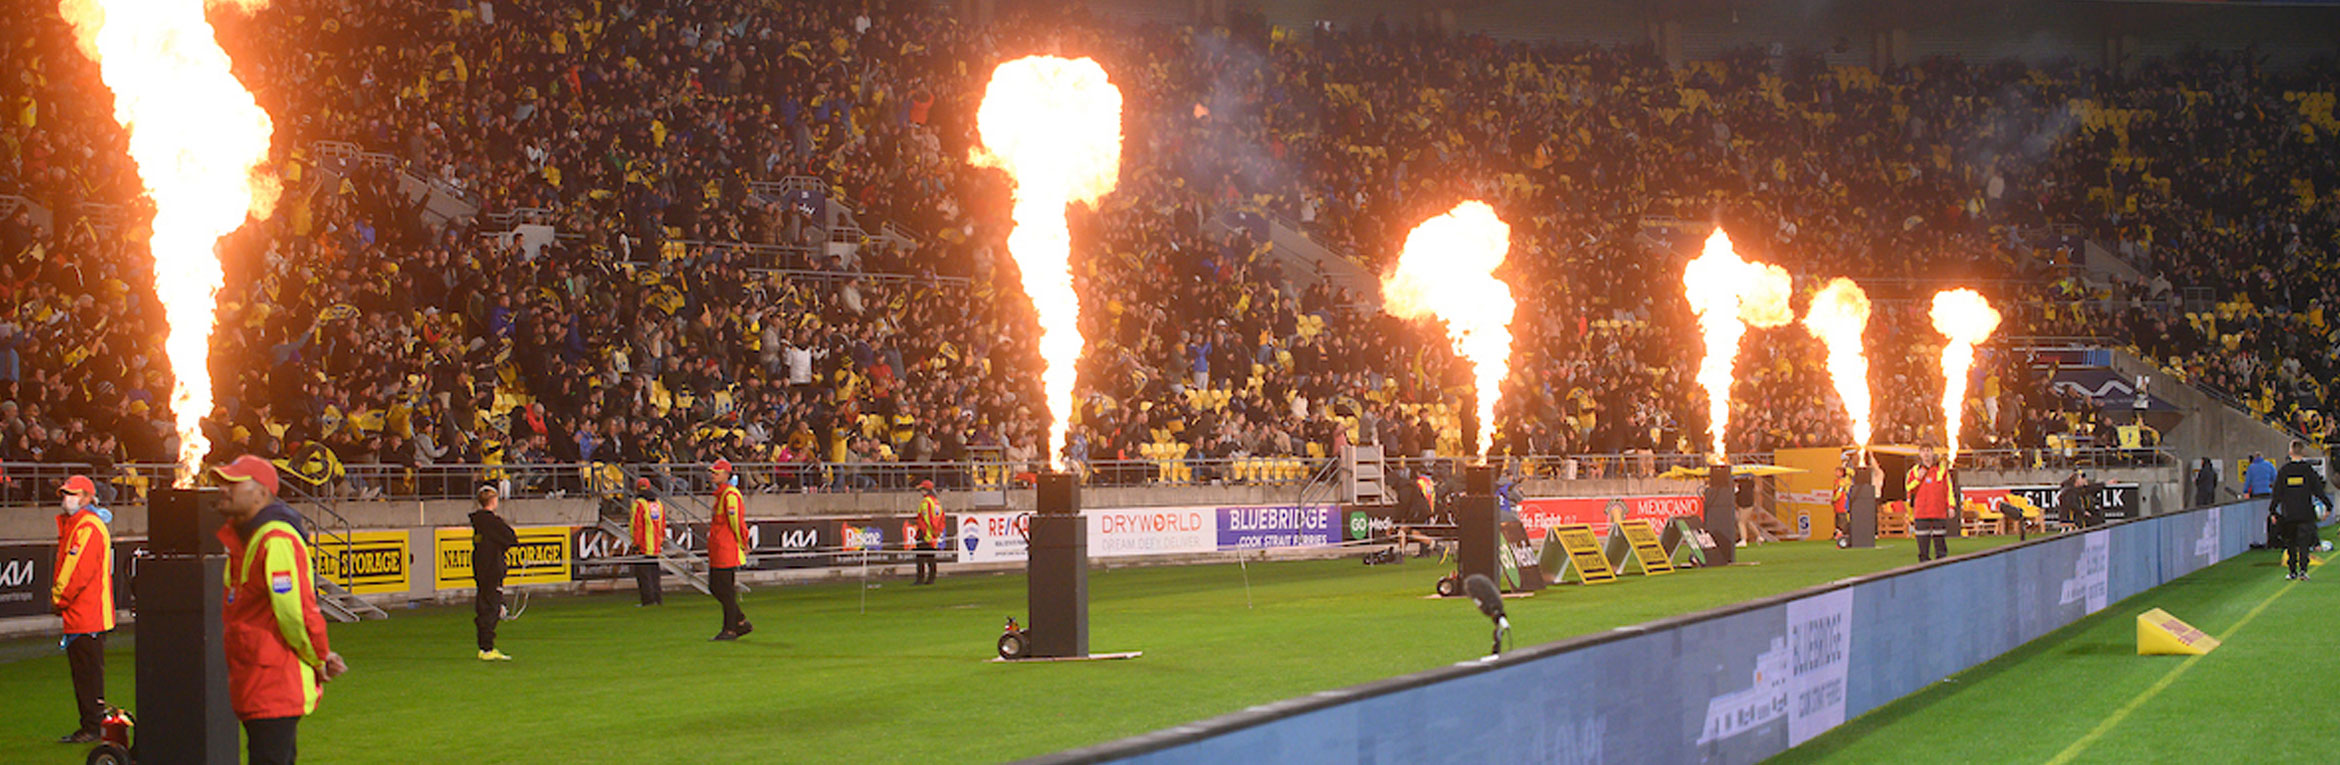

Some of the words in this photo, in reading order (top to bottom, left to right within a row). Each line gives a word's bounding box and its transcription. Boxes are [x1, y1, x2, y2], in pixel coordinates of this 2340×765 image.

[1637, 500, 1698, 516] MEXICANO
[988, 516, 1030, 536] RE/MA
[1102, 513, 1202, 533] DRYWORLD
[1229, 508, 1328, 530] BLUEBRIDGE
[1350, 517, 1367, 531] GO
[1240, 535, 1261, 547] COOK
[340, 551, 401, 575] STORAGE
[505, 544, 562, 567] STORAGE
